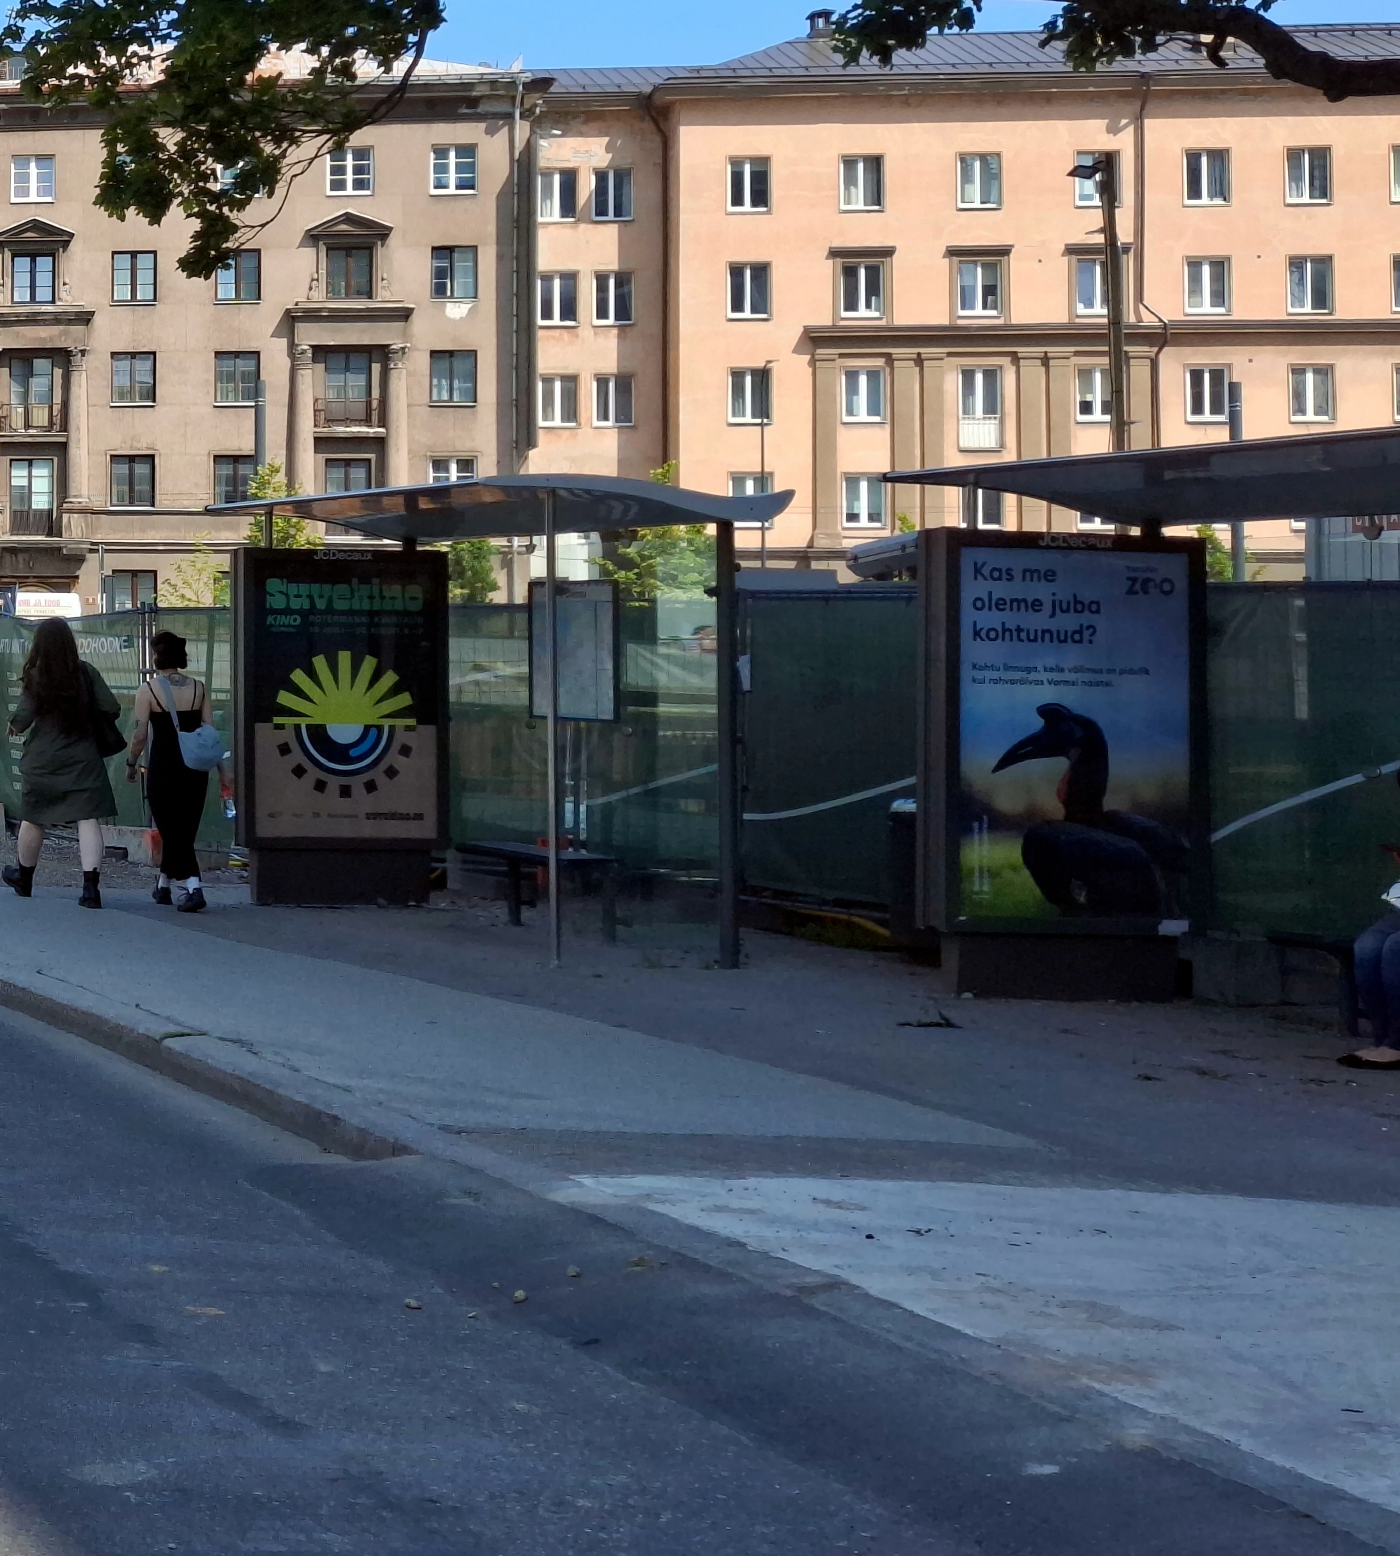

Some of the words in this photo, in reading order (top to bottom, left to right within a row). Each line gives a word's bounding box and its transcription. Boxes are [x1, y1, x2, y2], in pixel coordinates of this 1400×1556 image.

[1038, 533, 1114, 548] JCDecaux
[313, 549, 373, 560] JCDecaux
[973, 560, 1015, 583] Kas
[1021, 567, 1058, 583] me
[266, 577, 424, 612] Suvekino
[972, 590, 1044, 613] oleme
[1049, 591, 1101, 619] juba
[266, 614, 302, 626] KINO
[972, 620, 1098, 645] kohtunud?
[971, 661, 1002, 672] Kohtu
[1046, 677, 1079, 687] Vormsi
